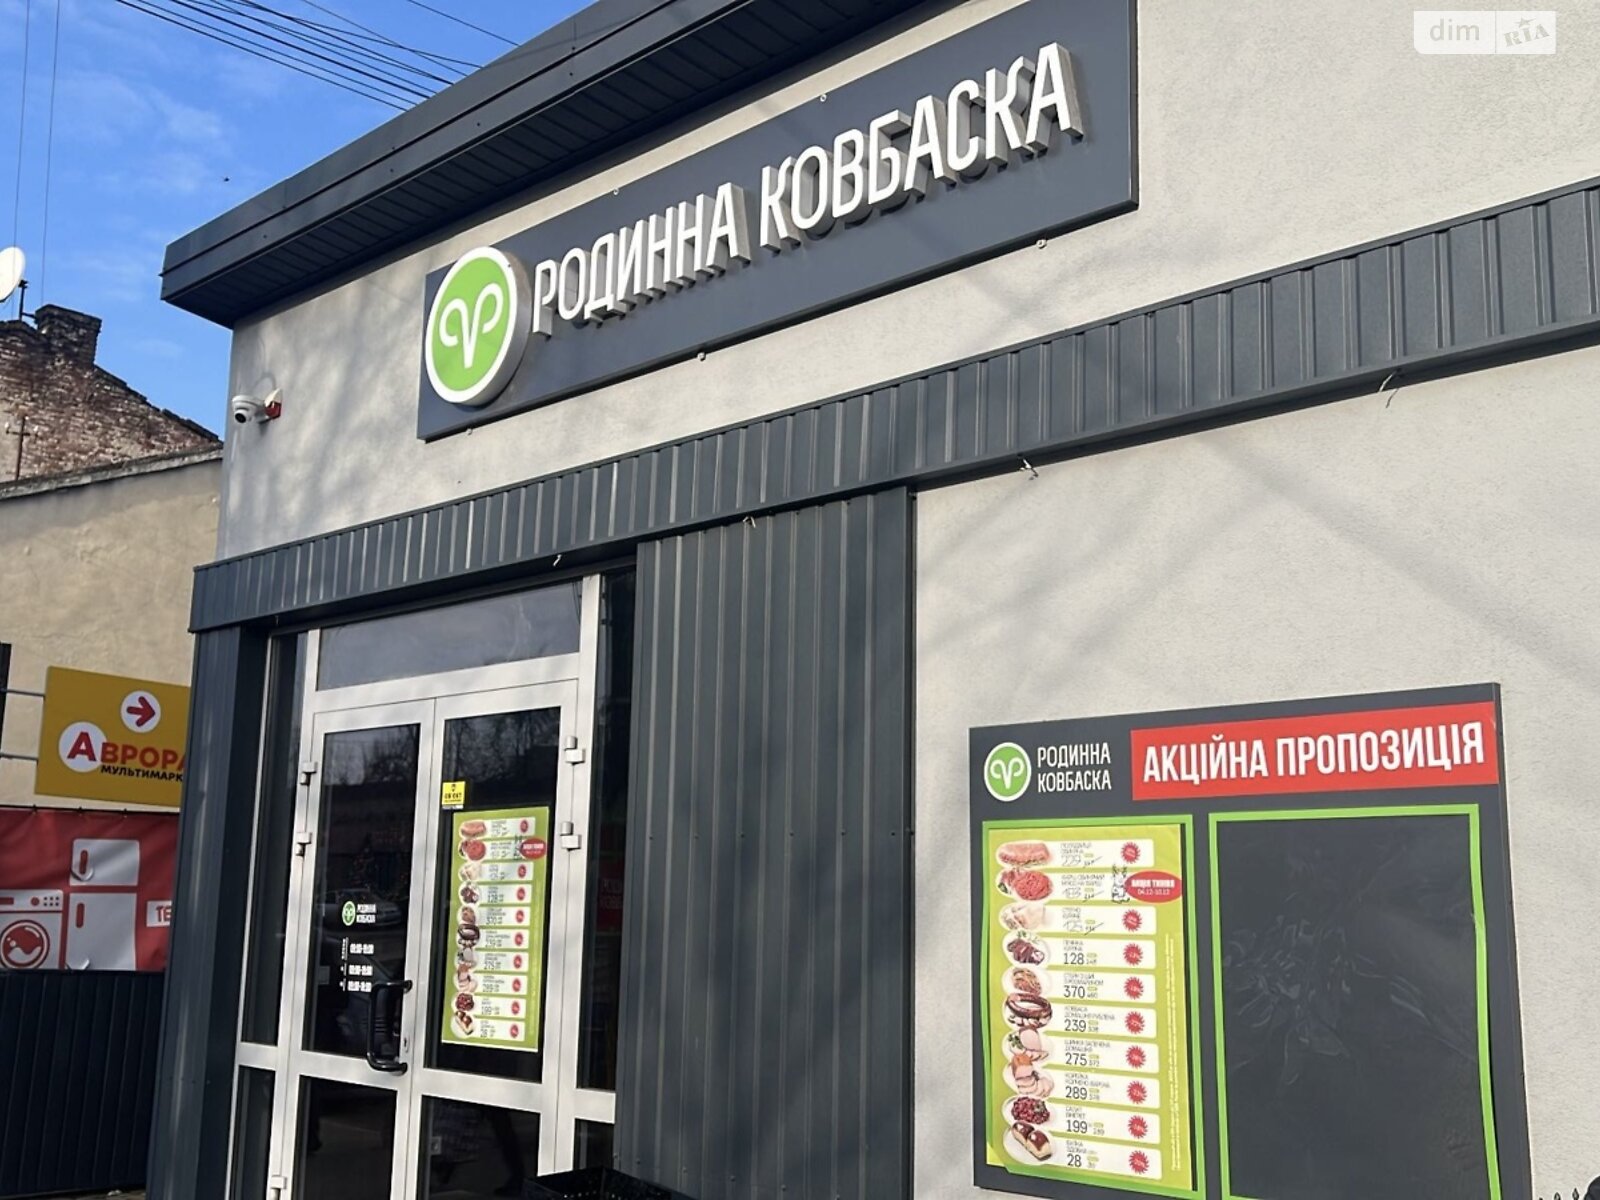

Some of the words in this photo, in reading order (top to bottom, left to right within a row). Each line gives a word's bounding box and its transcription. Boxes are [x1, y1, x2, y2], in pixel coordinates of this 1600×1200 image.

[532, 181, 750, 337] РОДИННА
[760, 42, 1084, 253] КОВБАСКА
[1036, 744, 1112, 769] РОДИННА
[1143, 733, 1268, 786] АКЦІЙНА
[1276, 720, 1485, 777] ПРОПОЗИЦІЯ
[1037, 769, 1113, 794] КОВБАСКА
[1063, 952, 1084, 965] 128
[1063, 985, 1086, 999] 370
[1064, 1019, 1087, 1033] 239
[1065, 1052, 1088, 1067] 275
[1065, 1085, 1088, 1100] 289
[1066, 1119, 1088, 1134] 199
[1066, 1153, 1083, 1168] 28
